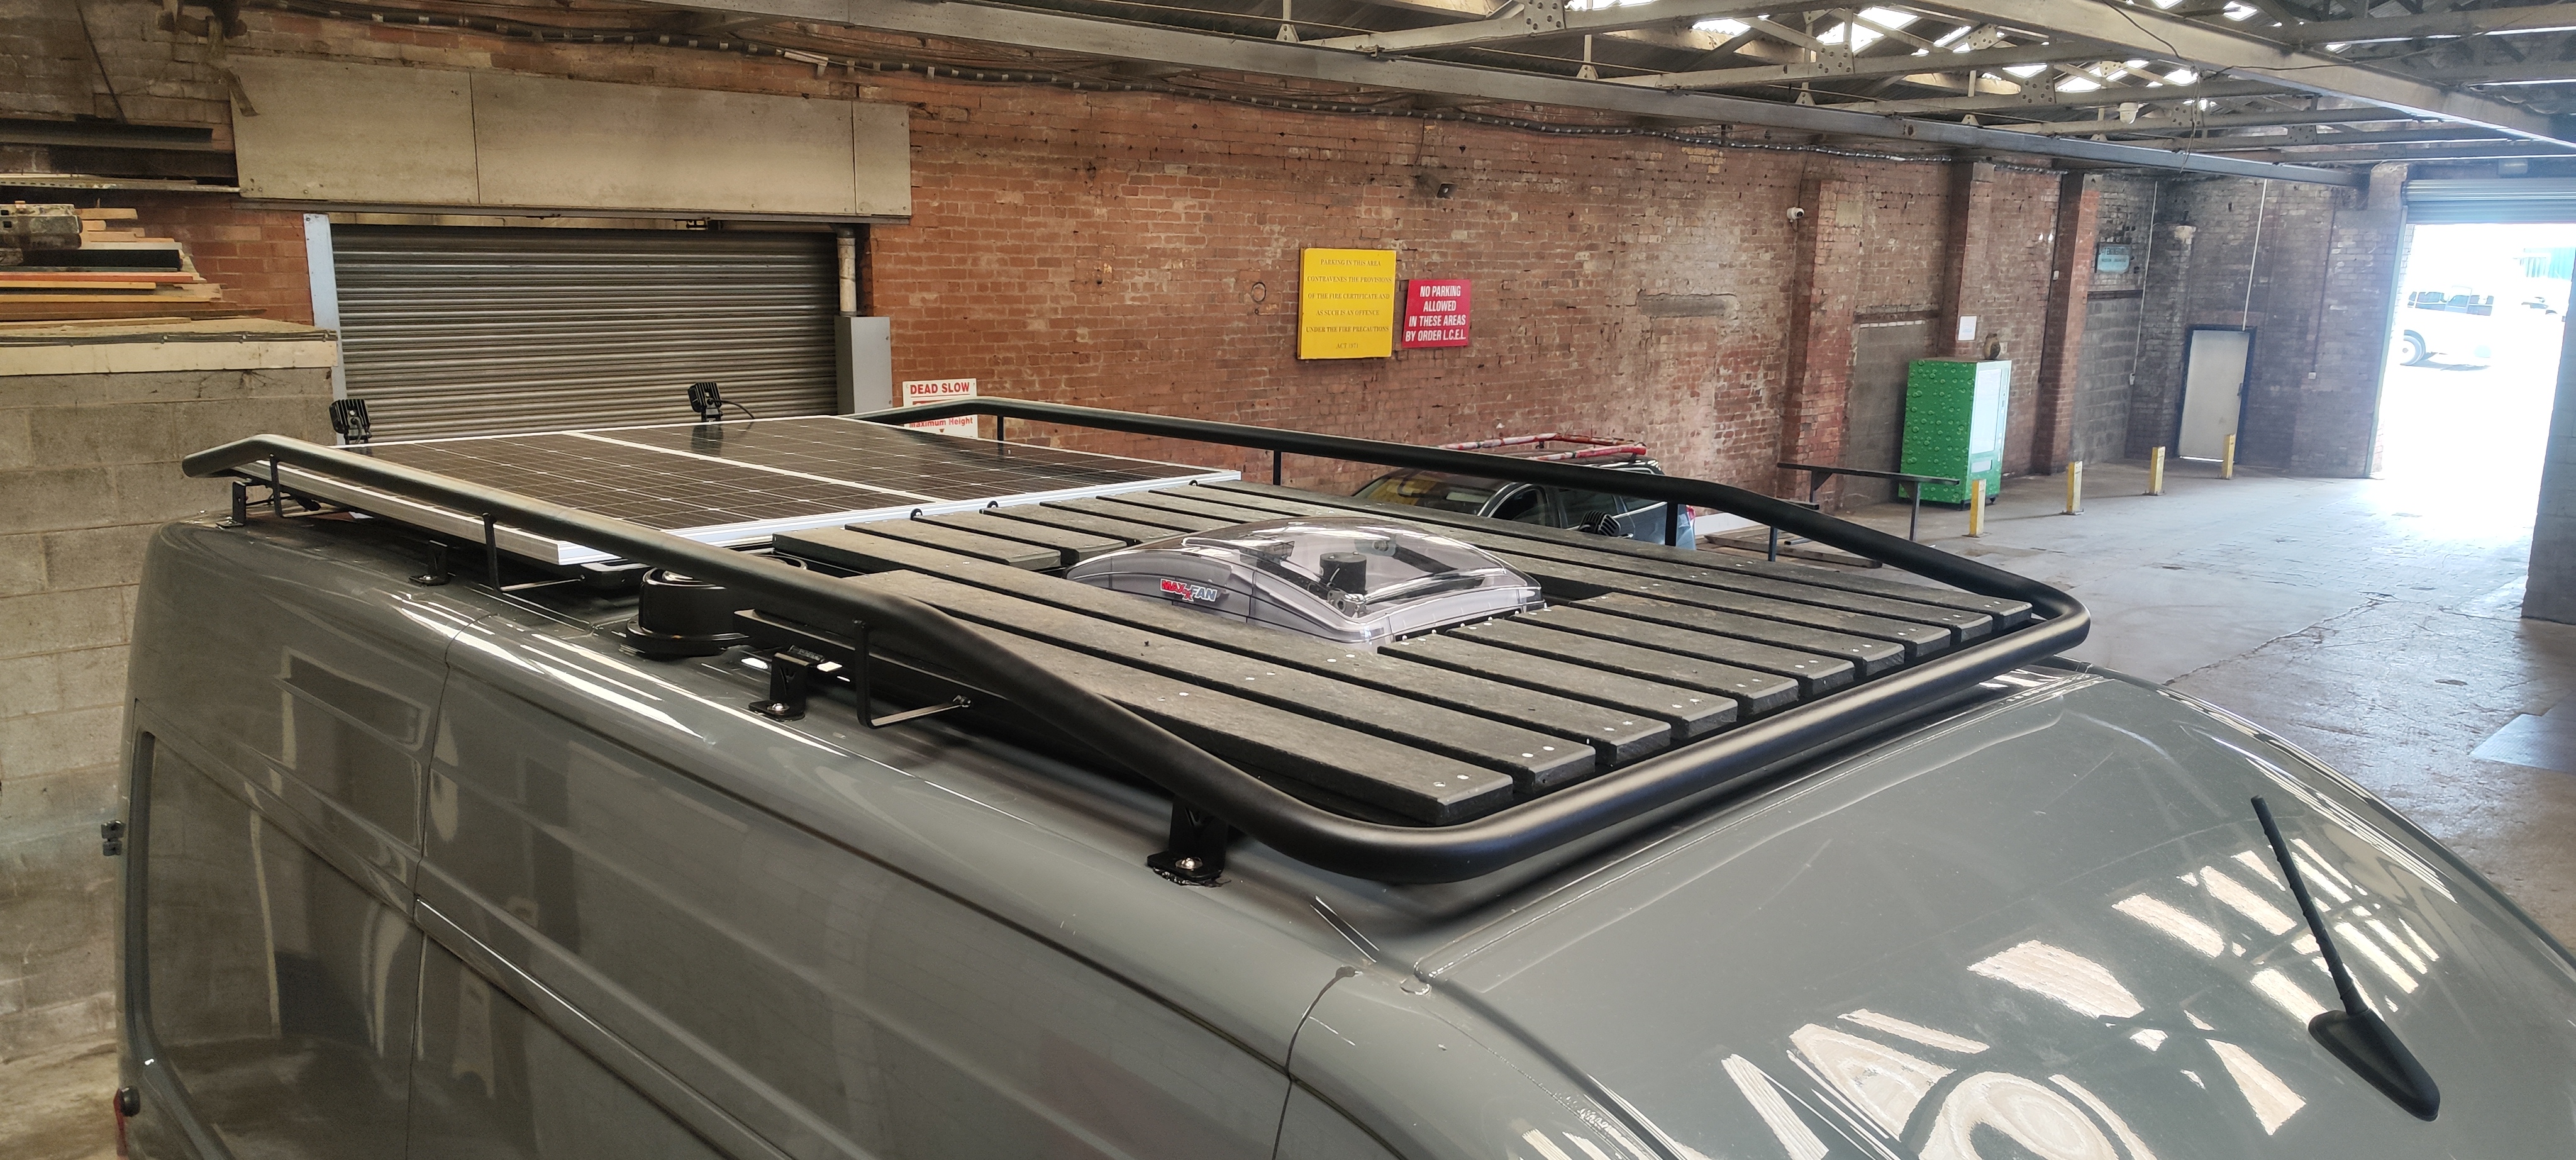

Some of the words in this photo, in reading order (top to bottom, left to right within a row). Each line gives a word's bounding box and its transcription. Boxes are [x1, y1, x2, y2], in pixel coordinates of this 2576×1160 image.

[1419, 286, 1430, 298] NO
[1431, 285, 1462, 298] PARKING
[1423, 300, 1457, 312] ALLOWED
[1408, 316, 1417, 327] IN
[1419, 315, 1442, 326] THESE
[1443, 315, 1467, 326] AREAS
[1405, 330, 1416, 342] BY
[1418, 330, 1442, 342] ORDER
[910, 383, 938, 395] DEAD
[941, 382, 970, 393] SLOW
[948, 417, 973, 427] Height
